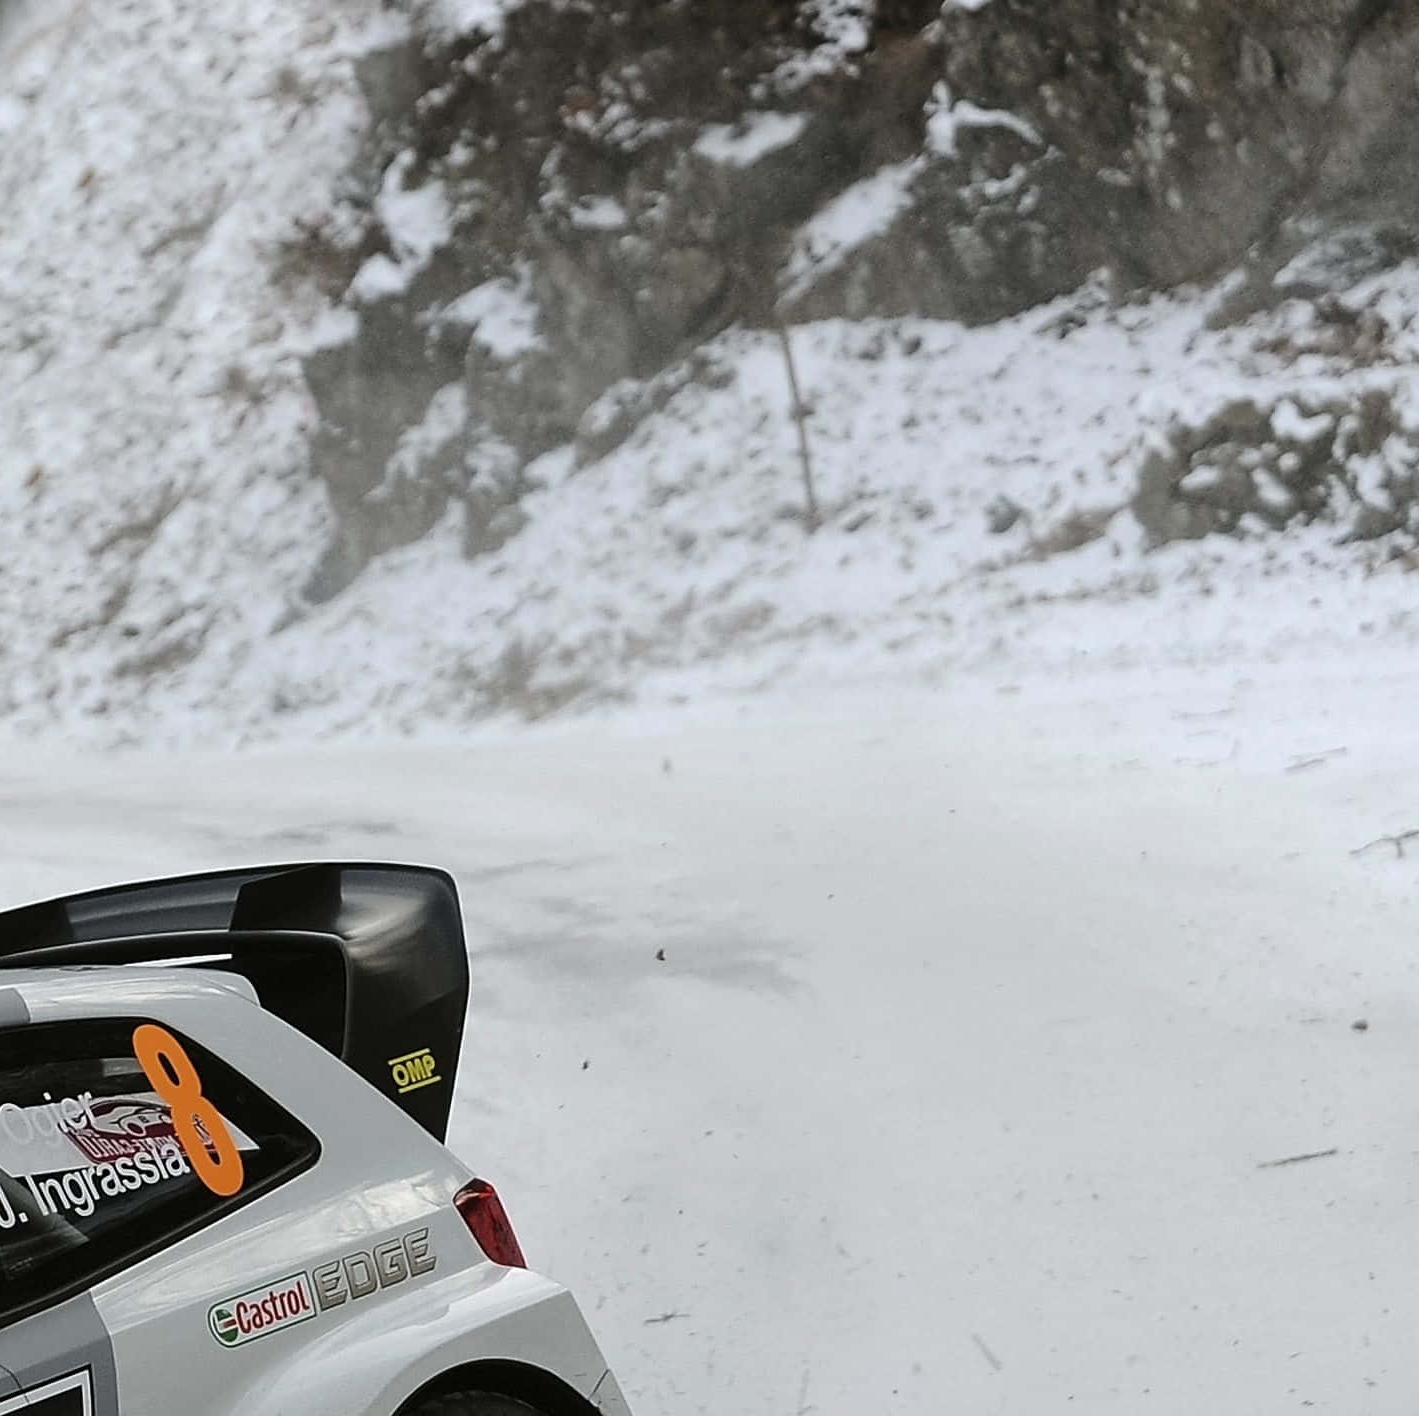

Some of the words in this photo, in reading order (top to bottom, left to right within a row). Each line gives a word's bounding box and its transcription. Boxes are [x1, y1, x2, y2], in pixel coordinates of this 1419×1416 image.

[392, 1054, 436, 1087] OMP
[0, 1091, 93, 1147] Ogier
[132, 1023, 244, 1197] 8
[24, 1141, 191, 1218] Ingrassia
[235, 1280, 311, 1334] Castrol
[312, 1226, 438, 1313] EDGE
